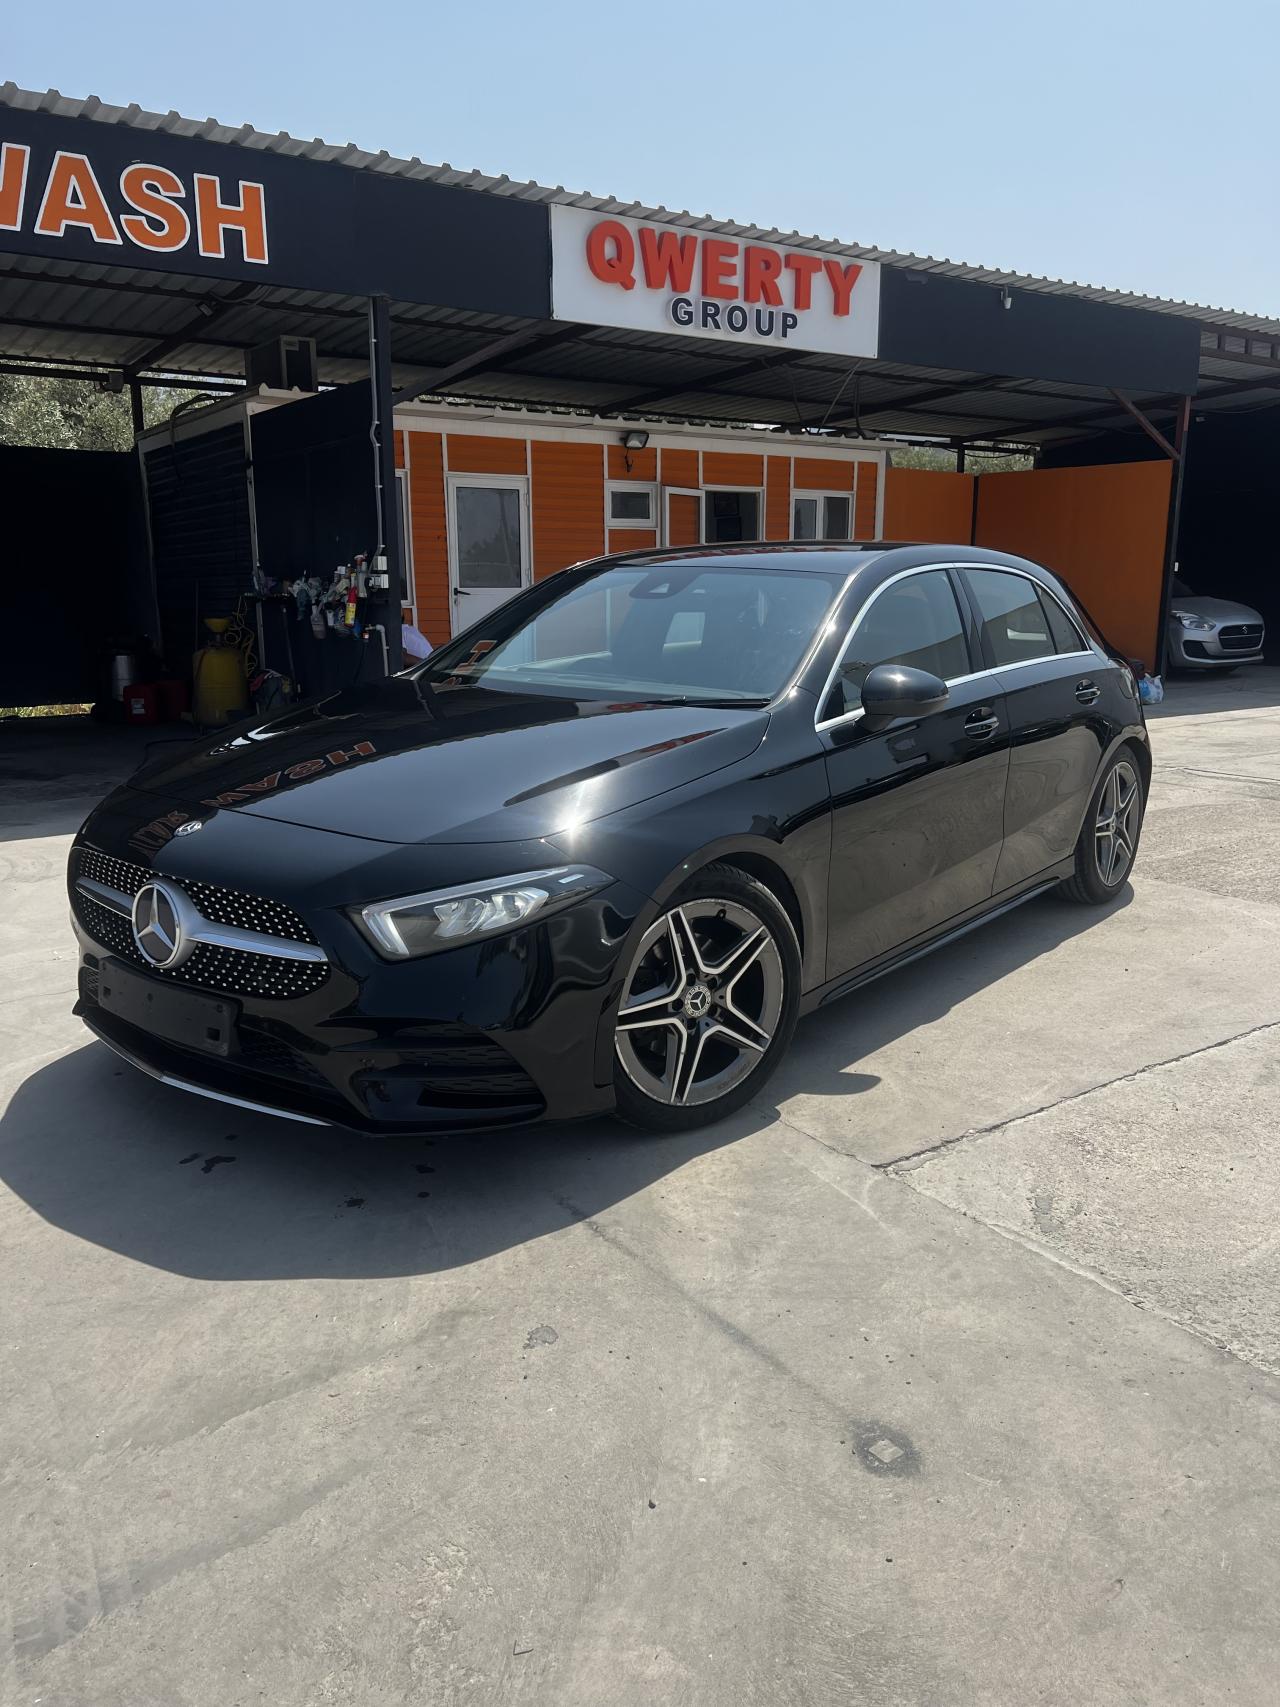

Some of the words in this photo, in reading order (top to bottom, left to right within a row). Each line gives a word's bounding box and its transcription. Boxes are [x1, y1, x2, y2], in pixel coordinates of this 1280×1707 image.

[0, 142, 268, 264] ASH
[586, 220, 863, 317] QWERTY
[671, 297, 798, 338] GROUP
